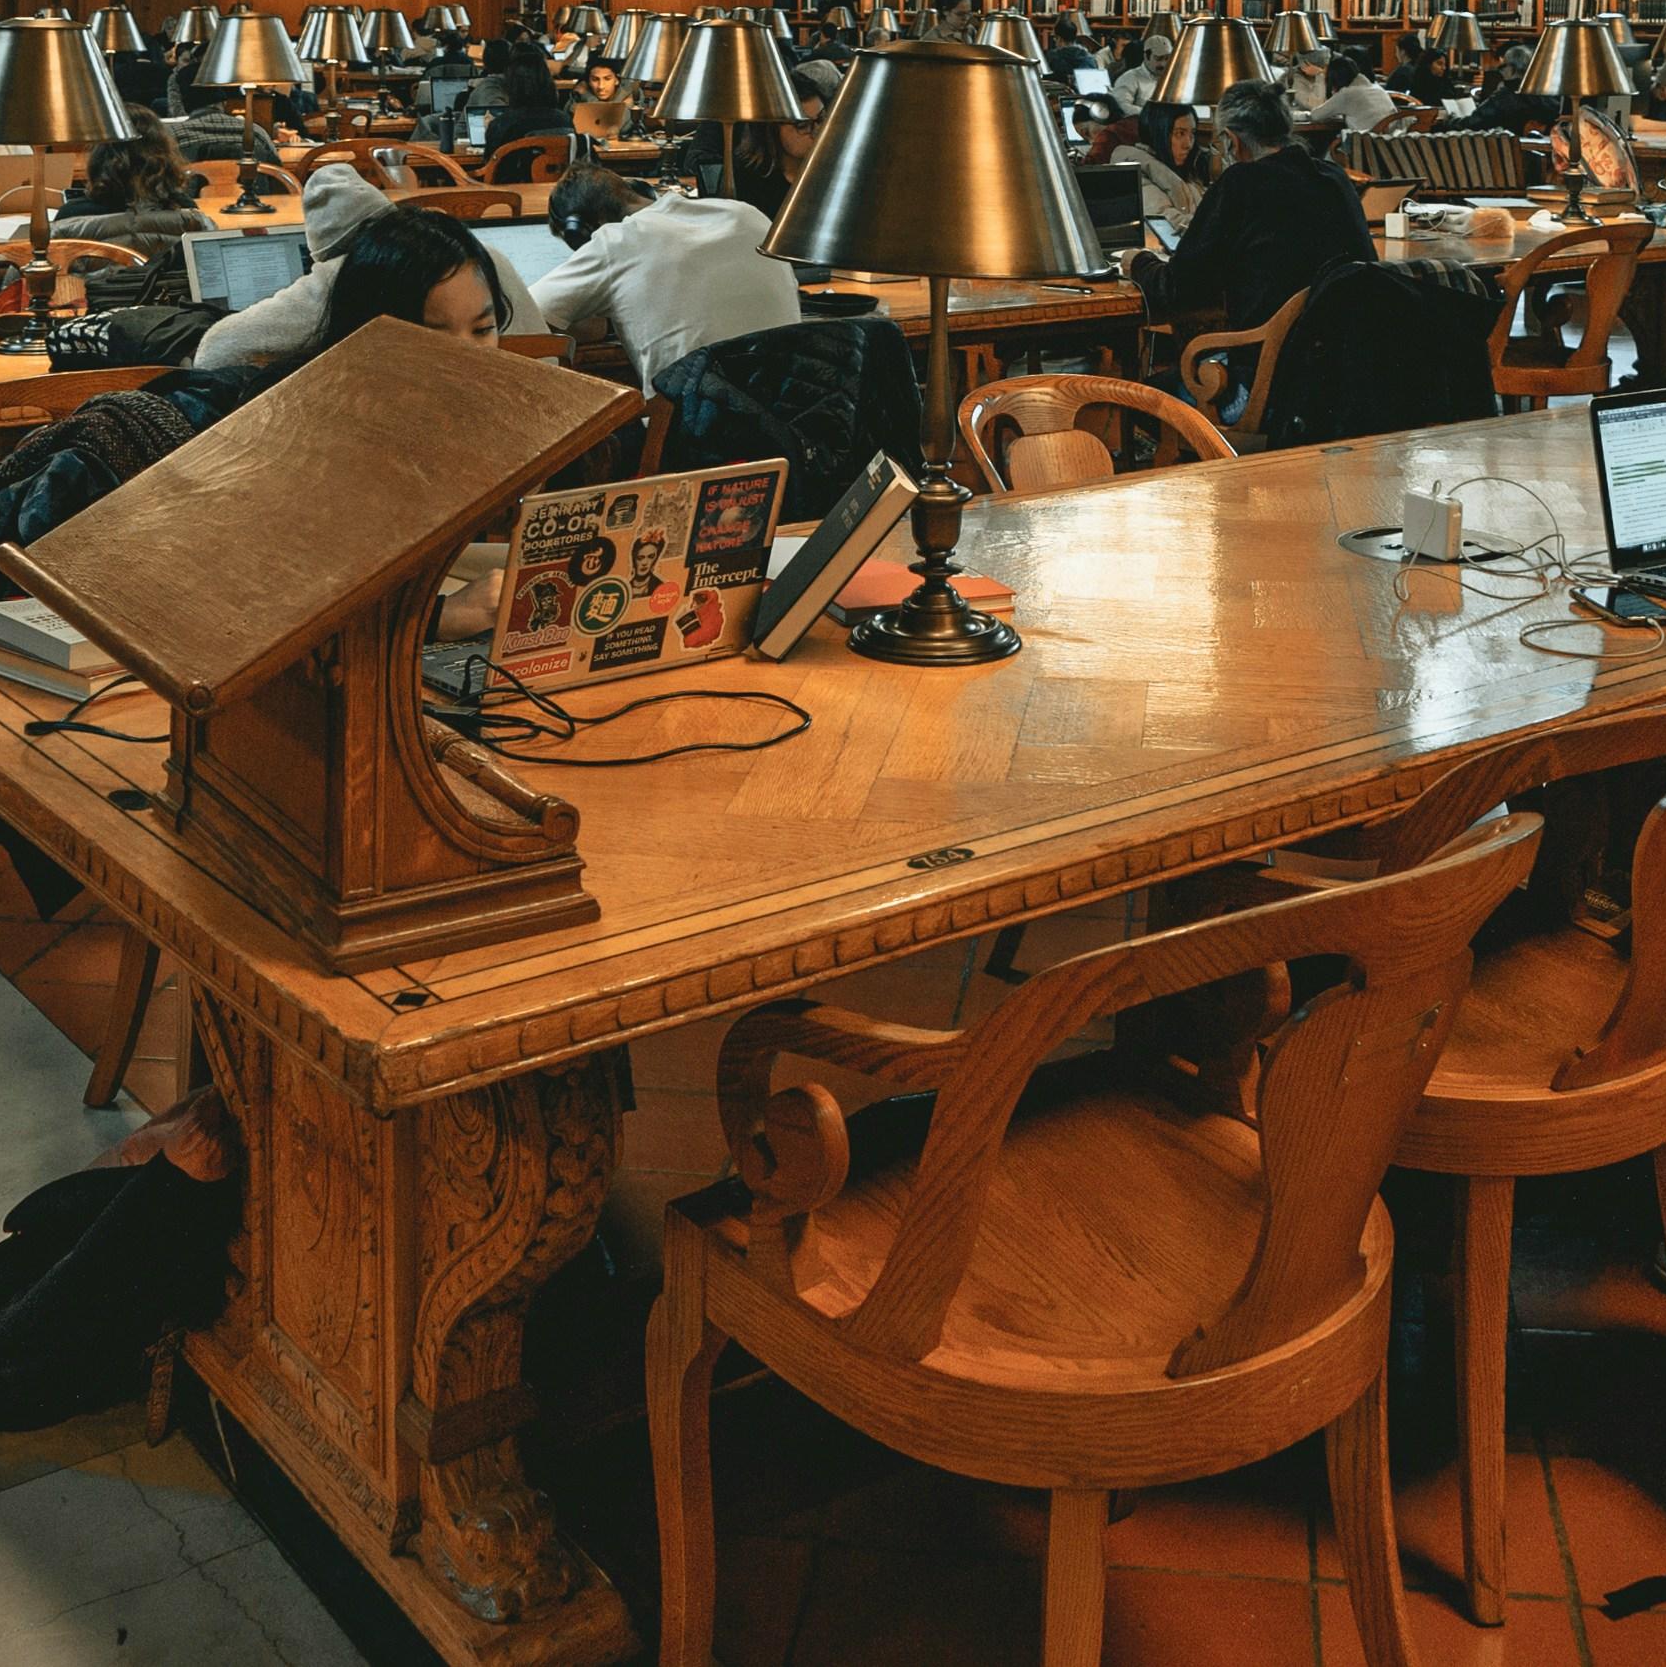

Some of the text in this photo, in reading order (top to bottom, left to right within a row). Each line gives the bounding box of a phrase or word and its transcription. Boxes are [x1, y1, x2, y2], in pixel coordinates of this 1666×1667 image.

[708, 477, 770, 496] IF NATURE
[530, 501, 598, 521] SEMINARY
[705, 502, 717, 512] IS
[527, 514, 596, 539] CO-OP
[698, 520, 750, 538] CHANGE
[523, 532, 593, 551] BOOKSTORES
[695, 535, 744, 553] NATURE
[694, 561, 719, 576] The
[616, 628, 633, 638] YOU
[634, 625, 656, 635] READ
[593, 652, 609, 662] SAY
